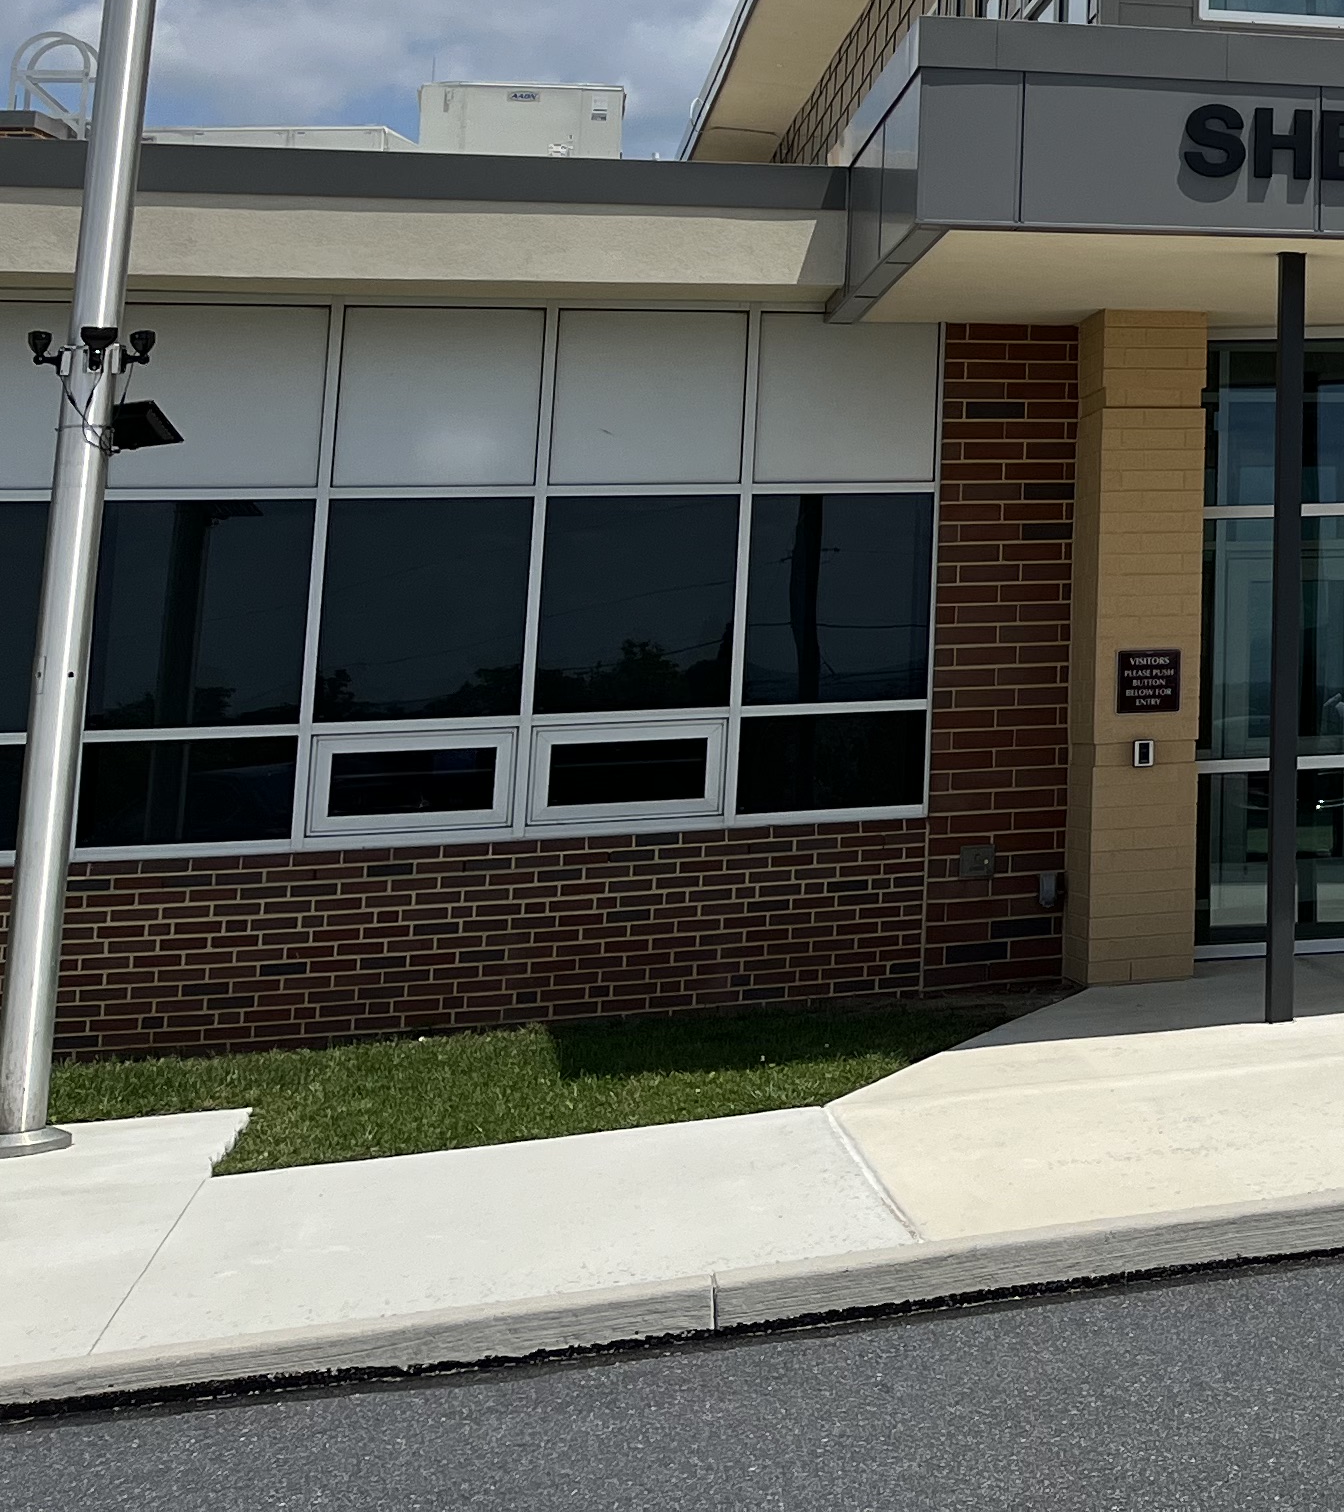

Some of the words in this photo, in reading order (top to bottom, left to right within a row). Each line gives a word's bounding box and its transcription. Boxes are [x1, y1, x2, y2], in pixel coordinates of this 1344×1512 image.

[1130, 656, 1170, 666] VISITORS
[1124, 669, 1151, 678] PLEASE
[1152, 668, 1175, 676] PUSH
[1132, 678, 1166, 687] BUTTON
[1125, 688, 1154, 697] BELOW
[1155, 688, 1172, 696] FOR
[1135, 698, 1161, 706] ENTRY
